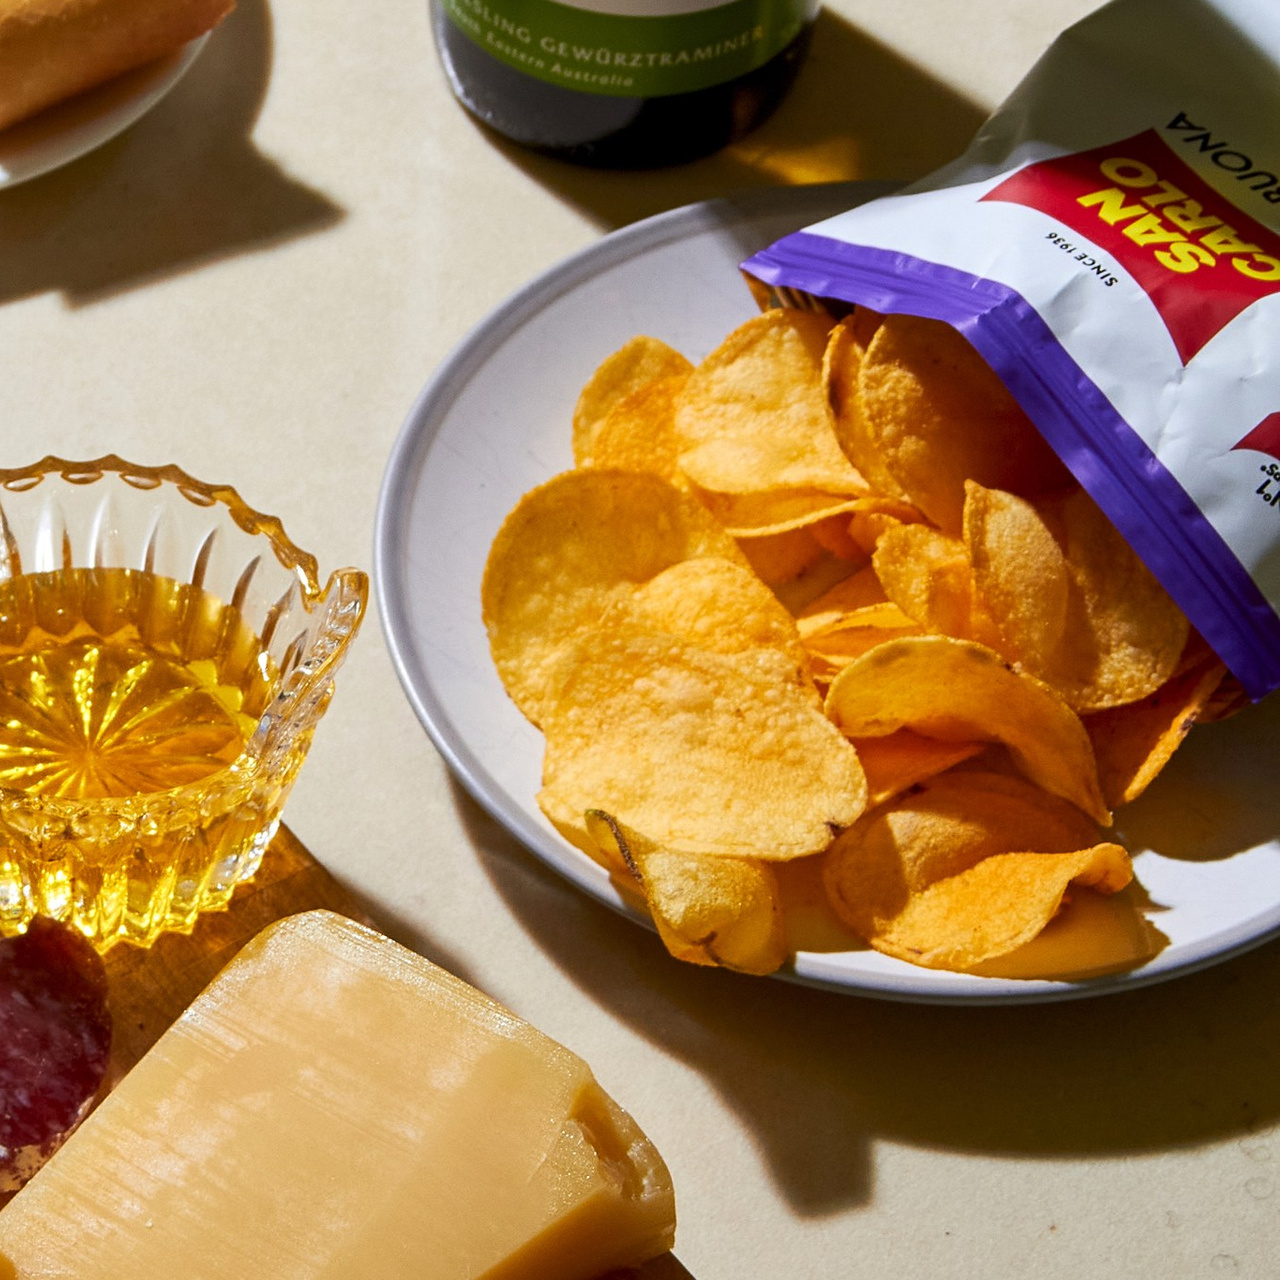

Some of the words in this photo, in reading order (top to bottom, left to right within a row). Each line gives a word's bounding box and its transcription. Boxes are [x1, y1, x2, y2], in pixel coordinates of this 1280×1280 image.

[539, 25, 765, 69] GEWÜRZTRAMINER
[549, 61, 635, 89] Australia
[1076, 186, 1216, 274] SAN
[1099, 156, 1280, 282] CARLO
[1045, 230, 1077, 255] 1936
[1076, 251, 1119, 288] SINCE
